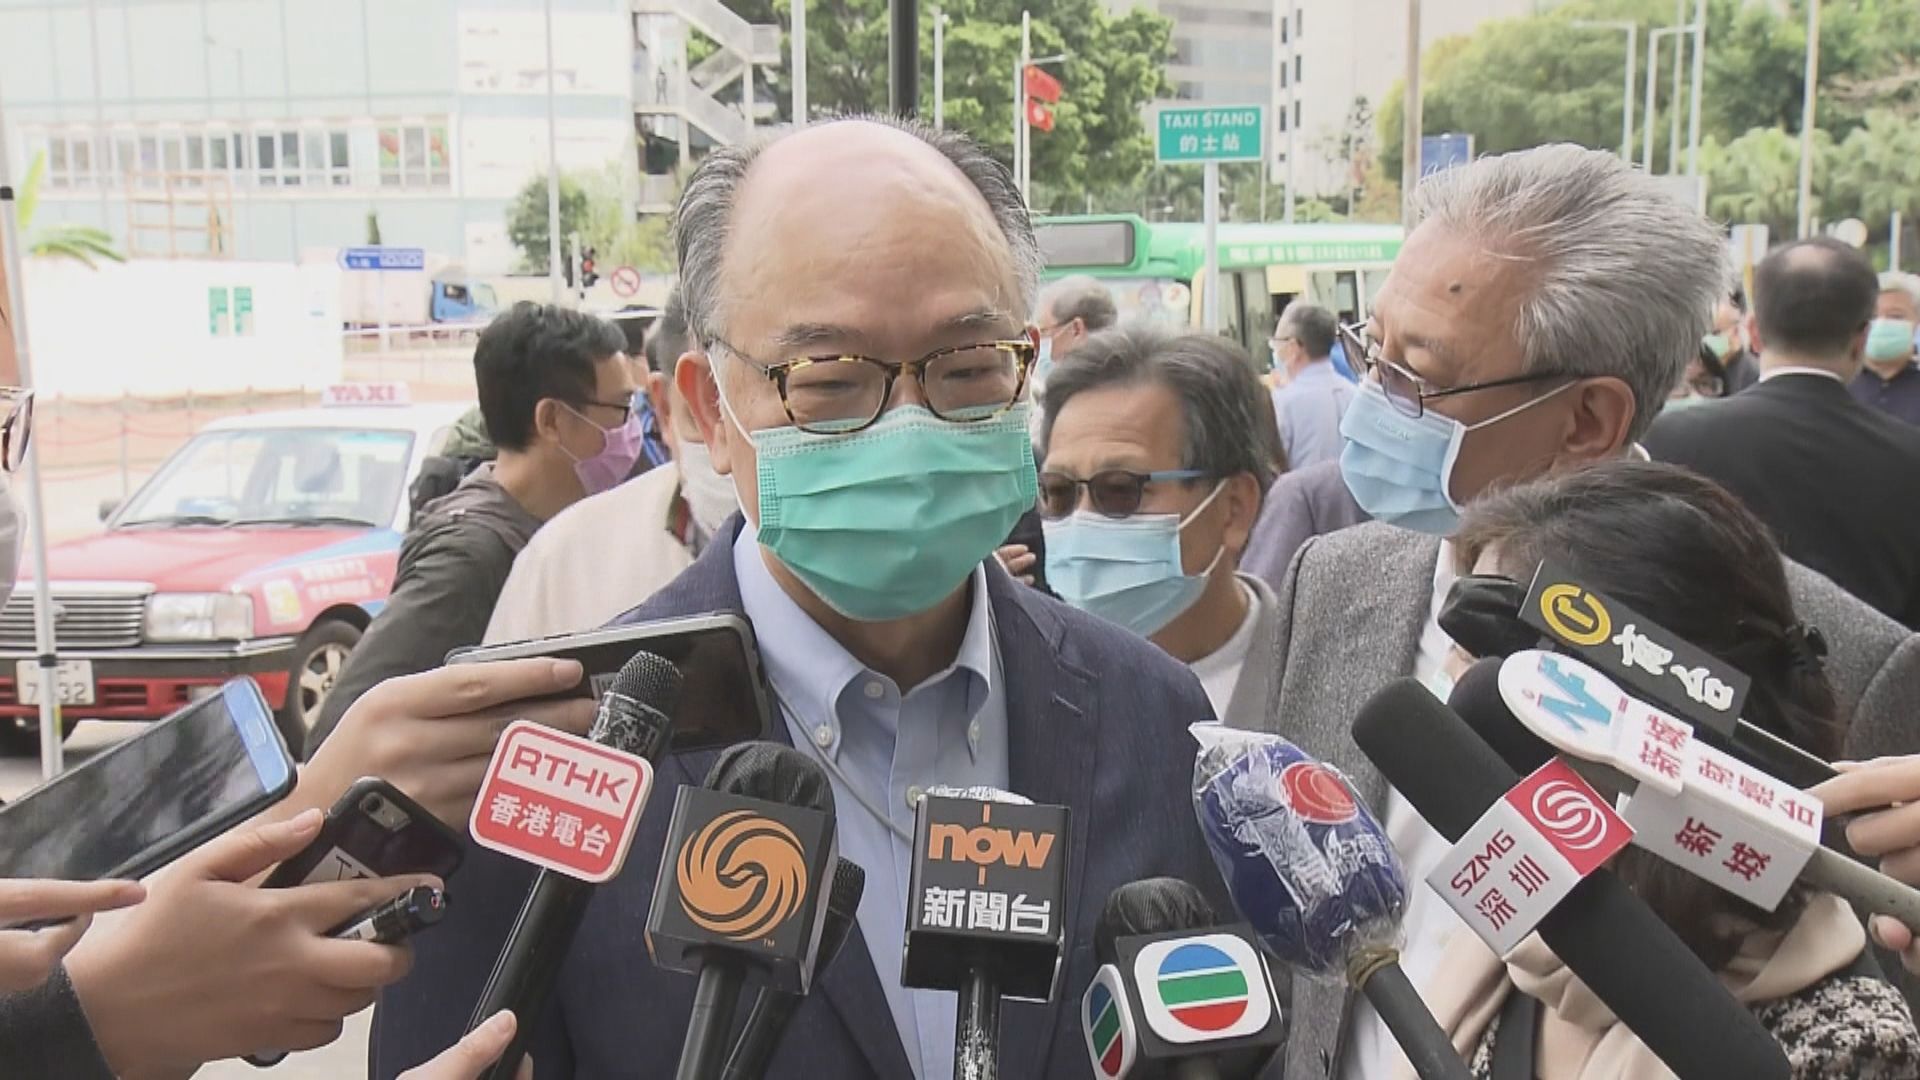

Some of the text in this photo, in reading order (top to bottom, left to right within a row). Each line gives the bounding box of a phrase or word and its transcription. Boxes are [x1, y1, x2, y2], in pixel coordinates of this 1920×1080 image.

[1163, 111, 1256, 129] TAXI STAND
[1180, 132, 1240, 153] 的士站
[330, 384, 395, 402] TAXI
[26, 682, 87, 704] 732
[511, 744, 629, 803] RTHK
[490, 792, 611, 858] 香港電台
[928, 823, 1055, 868] now
[1675, 817, 1771, 881] 新城
[1451, 829, 1515, 897] SZMG
[922, 886, 1051, 936] 新聞台
[1475, 854, 1551, 931] 深圳
